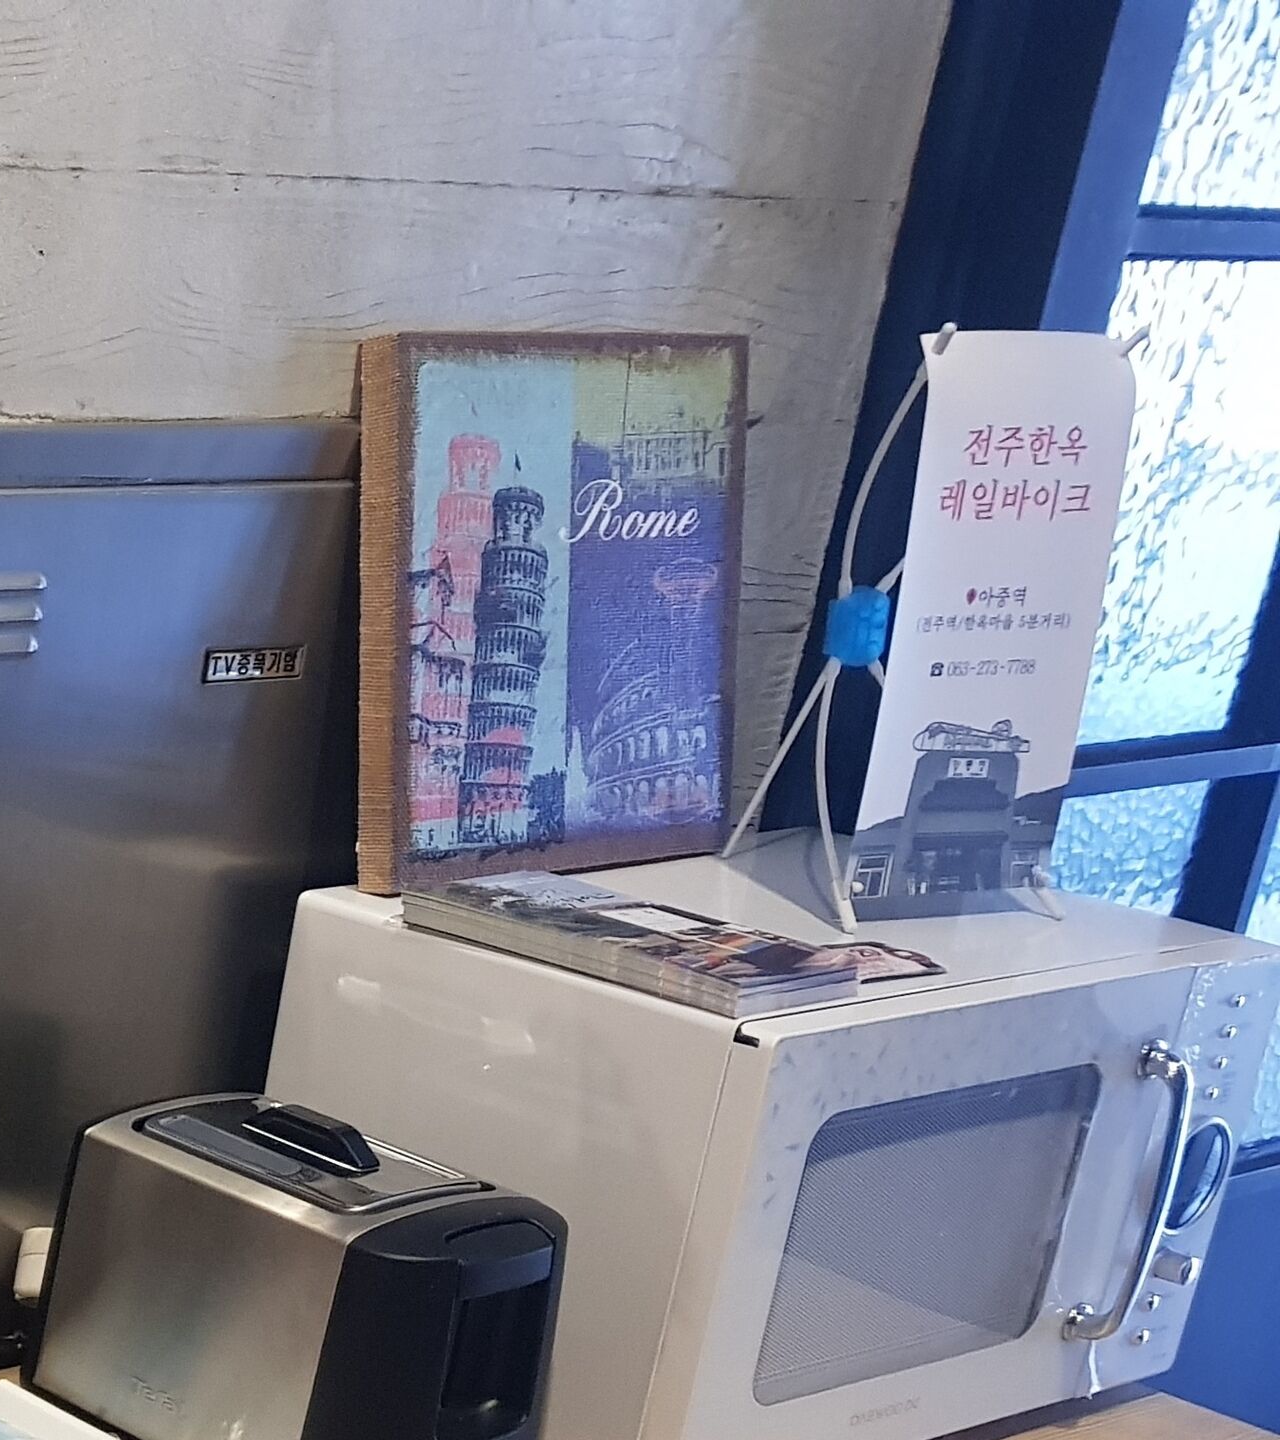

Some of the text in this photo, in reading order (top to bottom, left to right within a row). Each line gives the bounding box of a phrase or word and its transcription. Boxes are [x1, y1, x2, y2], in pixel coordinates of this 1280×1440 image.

[964, 424, 1088, 468] 전주한옥
[559, 479, 702, 543] Rome
[940, 478, 1092, 522] 레일바이크
[978, 585, 1028, 608] 아중역
